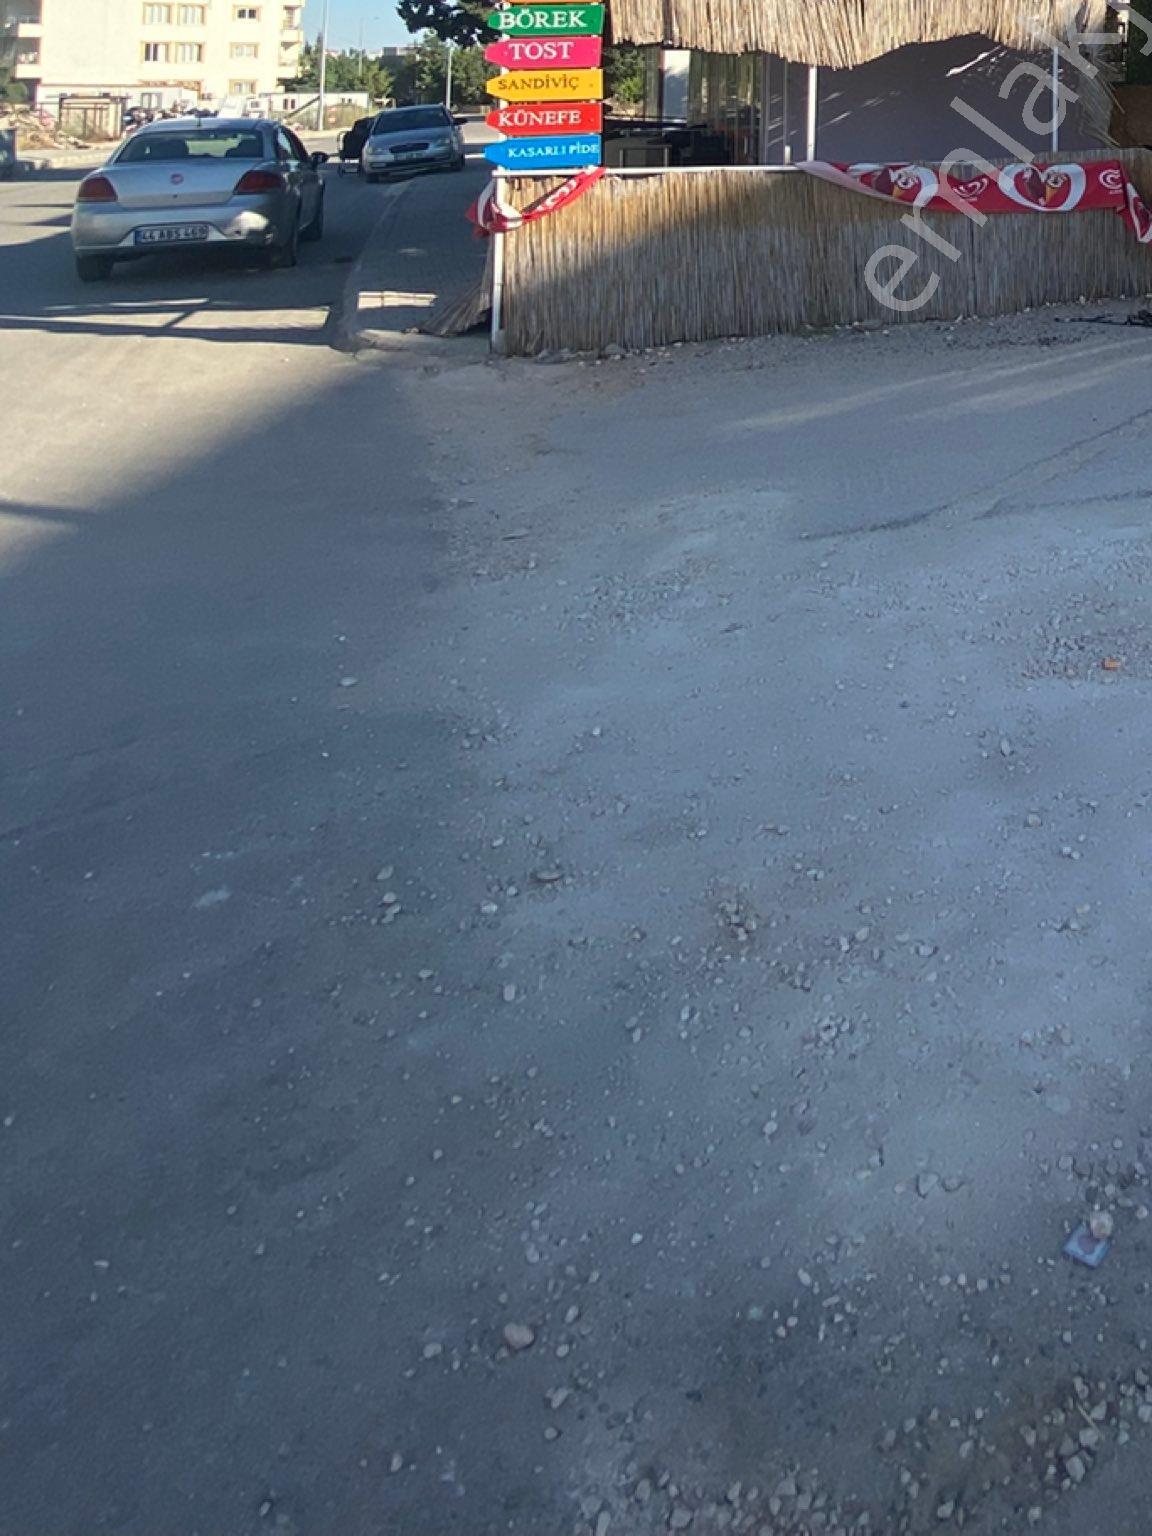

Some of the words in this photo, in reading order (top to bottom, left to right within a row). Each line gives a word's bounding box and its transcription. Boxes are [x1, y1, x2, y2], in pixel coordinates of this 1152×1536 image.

[499, 7, 587, 29] BÖREK
[508, 41, 574, 60] TOST
[498, 109, 582, 126] KÜNEFE
